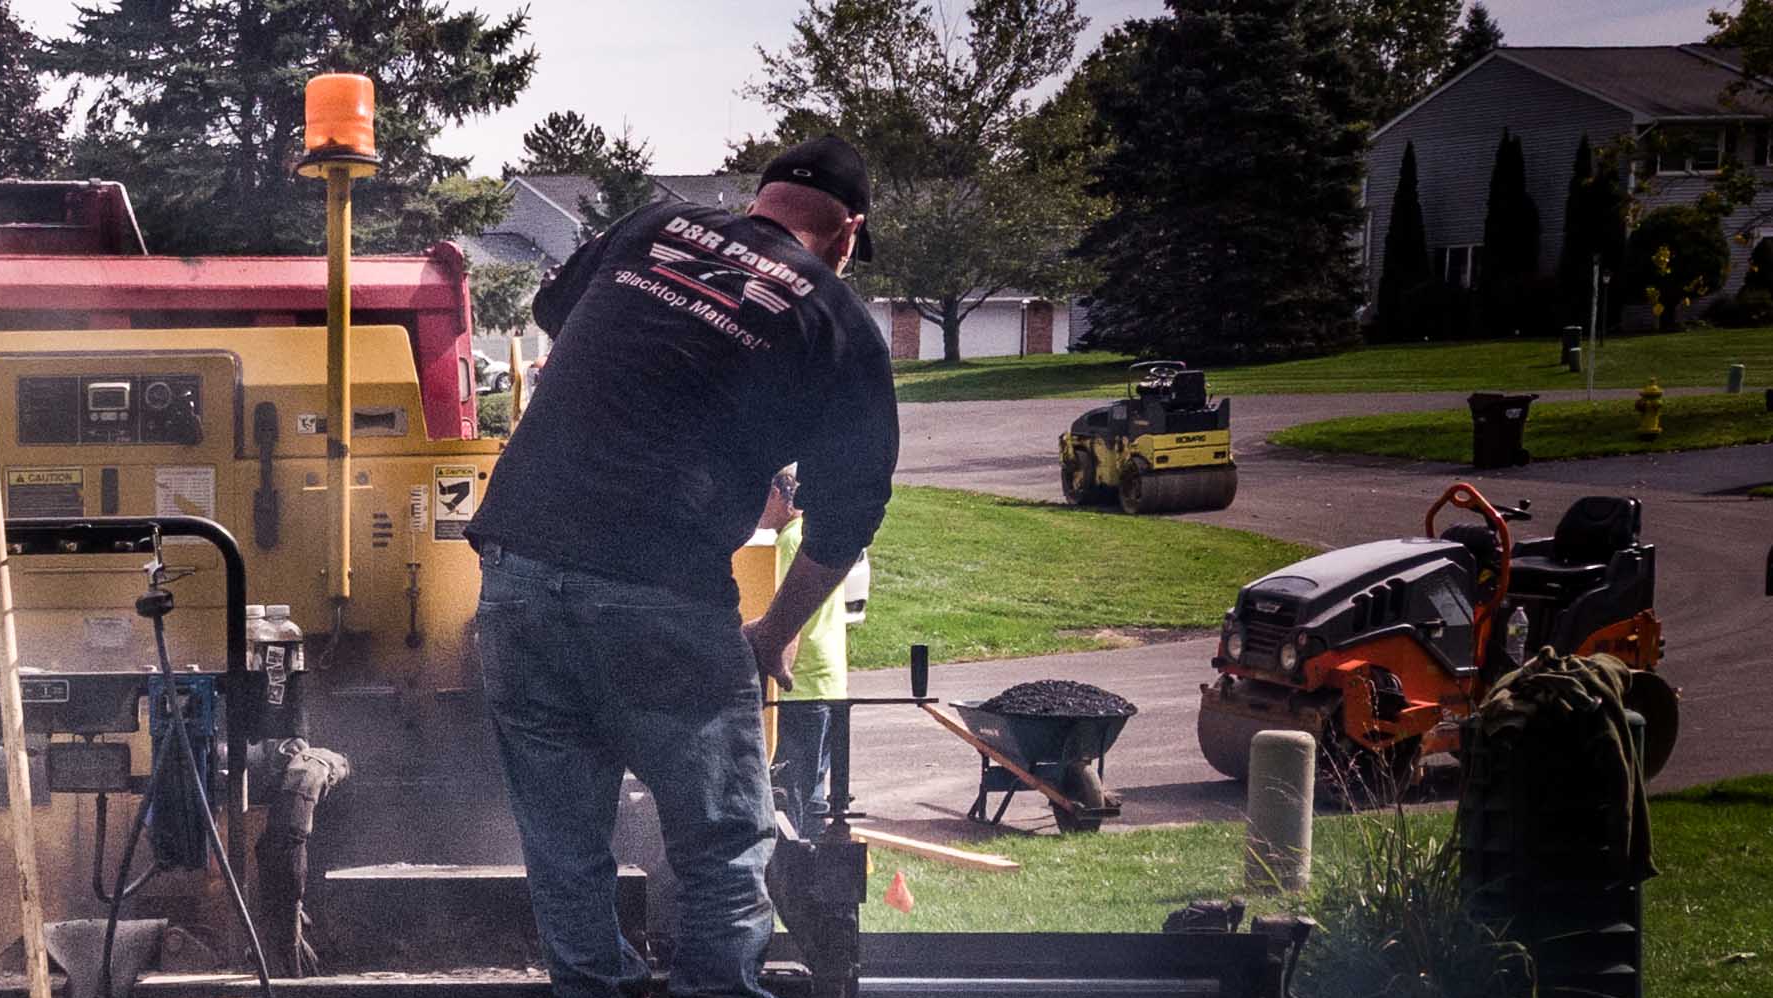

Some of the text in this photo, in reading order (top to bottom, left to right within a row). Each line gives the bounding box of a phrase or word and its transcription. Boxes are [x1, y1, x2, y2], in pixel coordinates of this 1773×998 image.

[664, 216, 815, 297] D&R Paving
[28, 473, 72, 483] CAUTION
